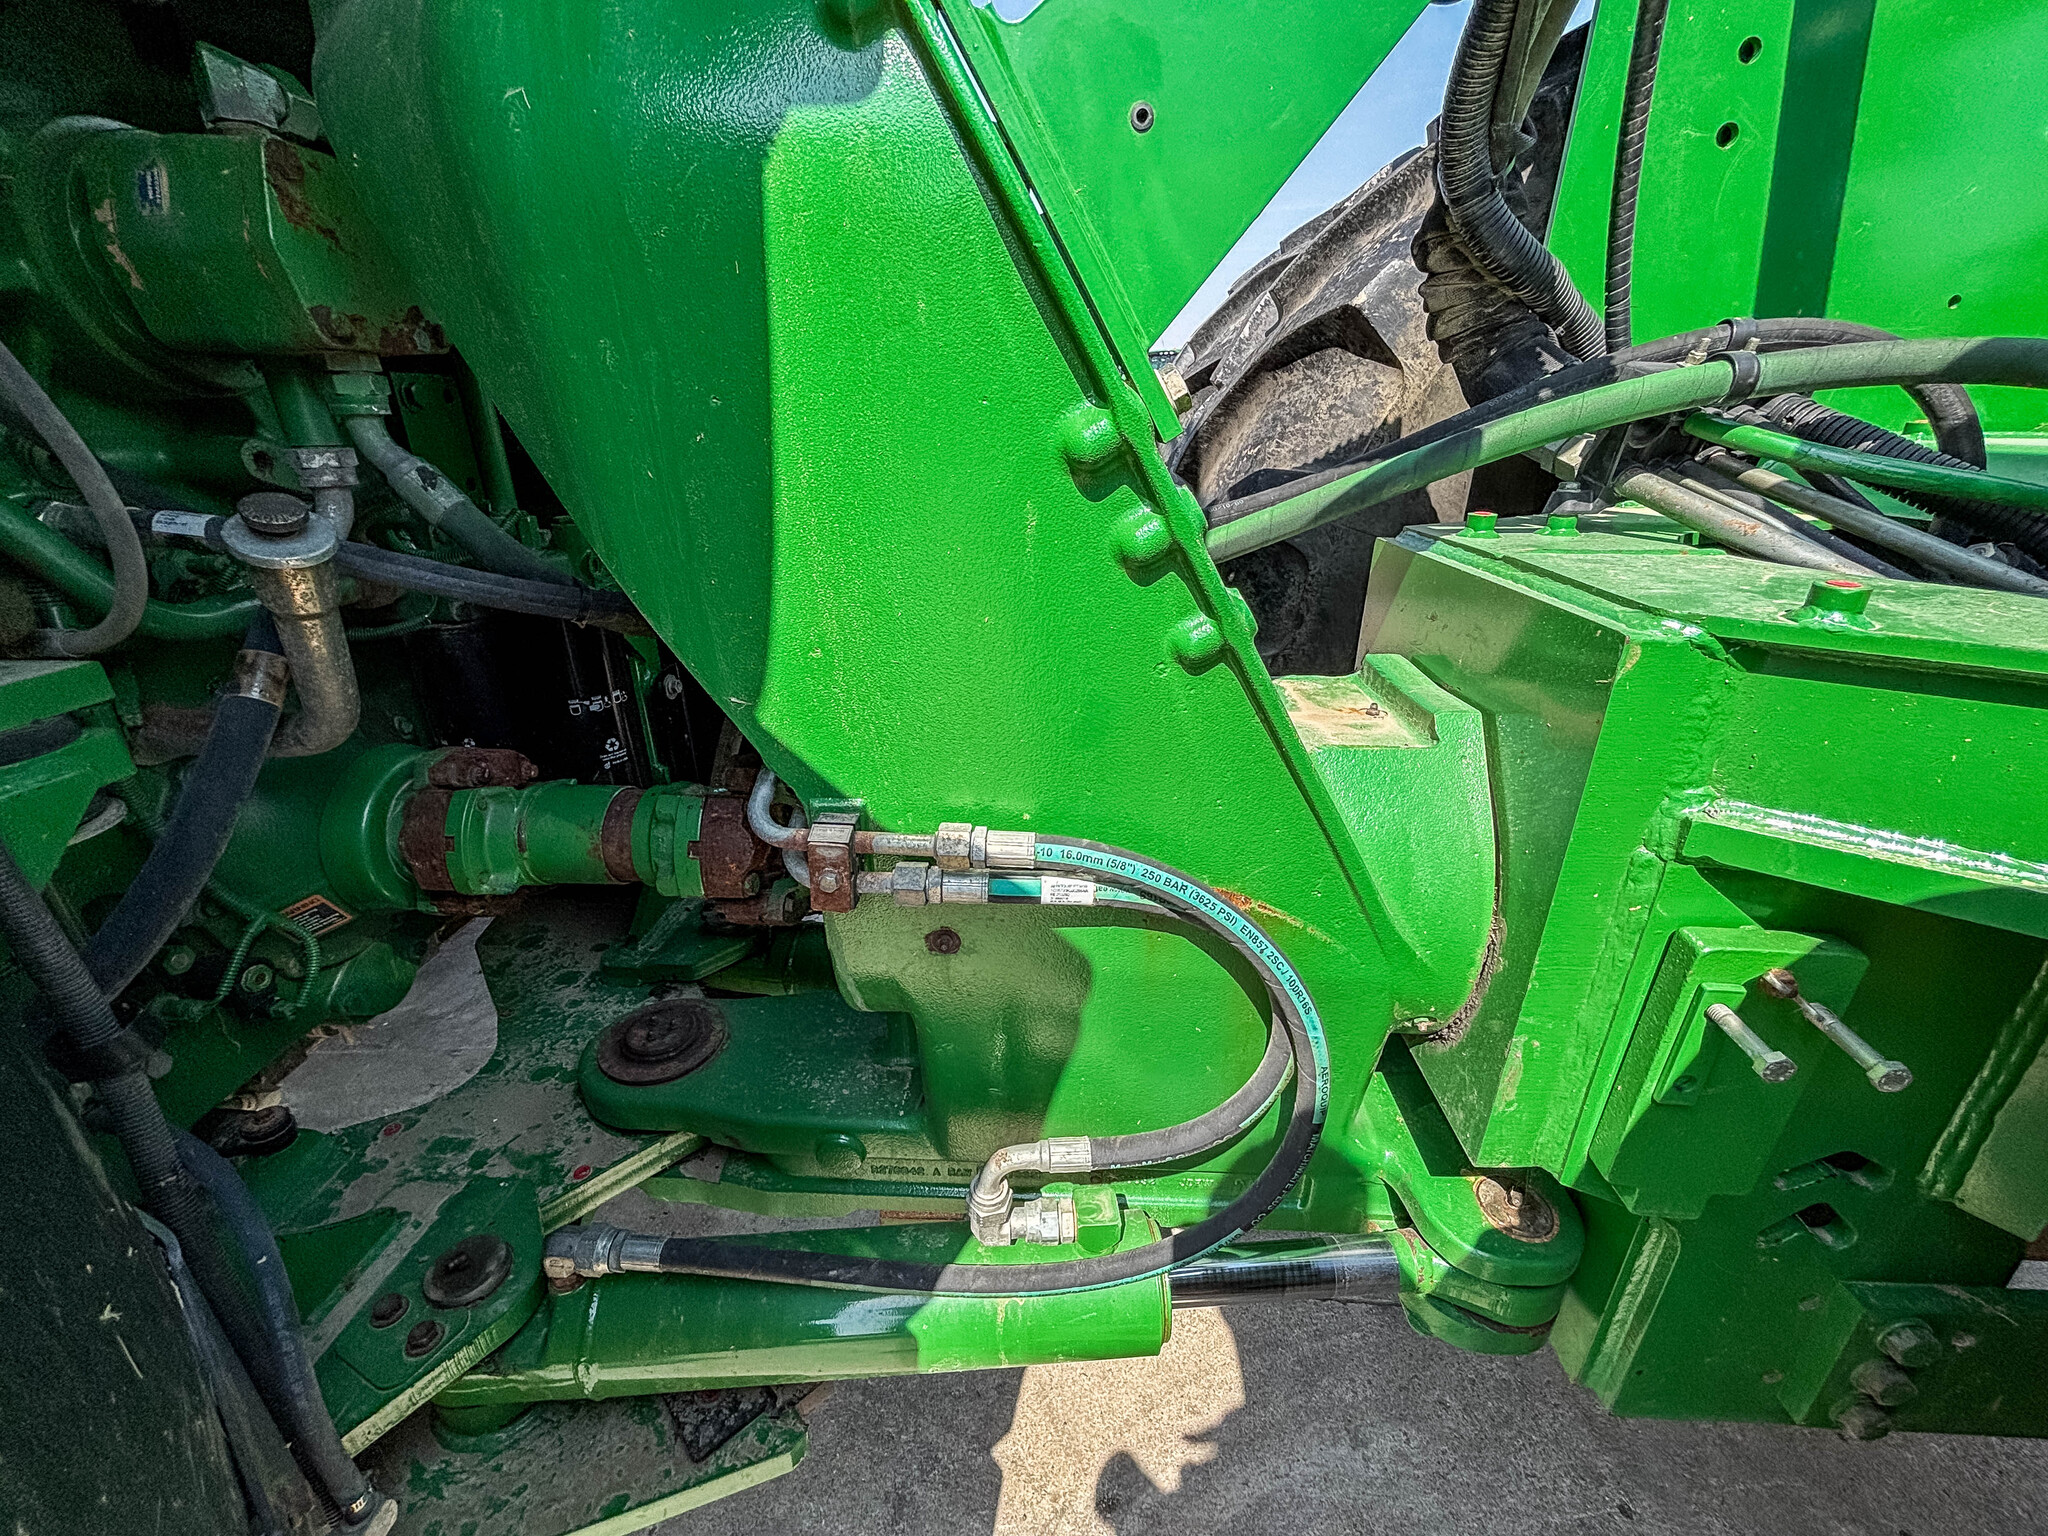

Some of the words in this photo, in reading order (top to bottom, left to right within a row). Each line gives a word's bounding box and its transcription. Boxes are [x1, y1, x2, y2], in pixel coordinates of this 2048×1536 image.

[1060, 848, 1104, 867] 16.0mm
[1140, 867, 1162, 884] 250
[1163, 876, 1189, 896] BAR
[1189, 889, 1218, 912] (3625
[1216, 907, 1239, 927] PSI)
[1239, 924, 1269, 953] EN857
[1266, 950, 1285, 972] 2SC
[1319, 1066, 1329, 1116] AEROQUIP
